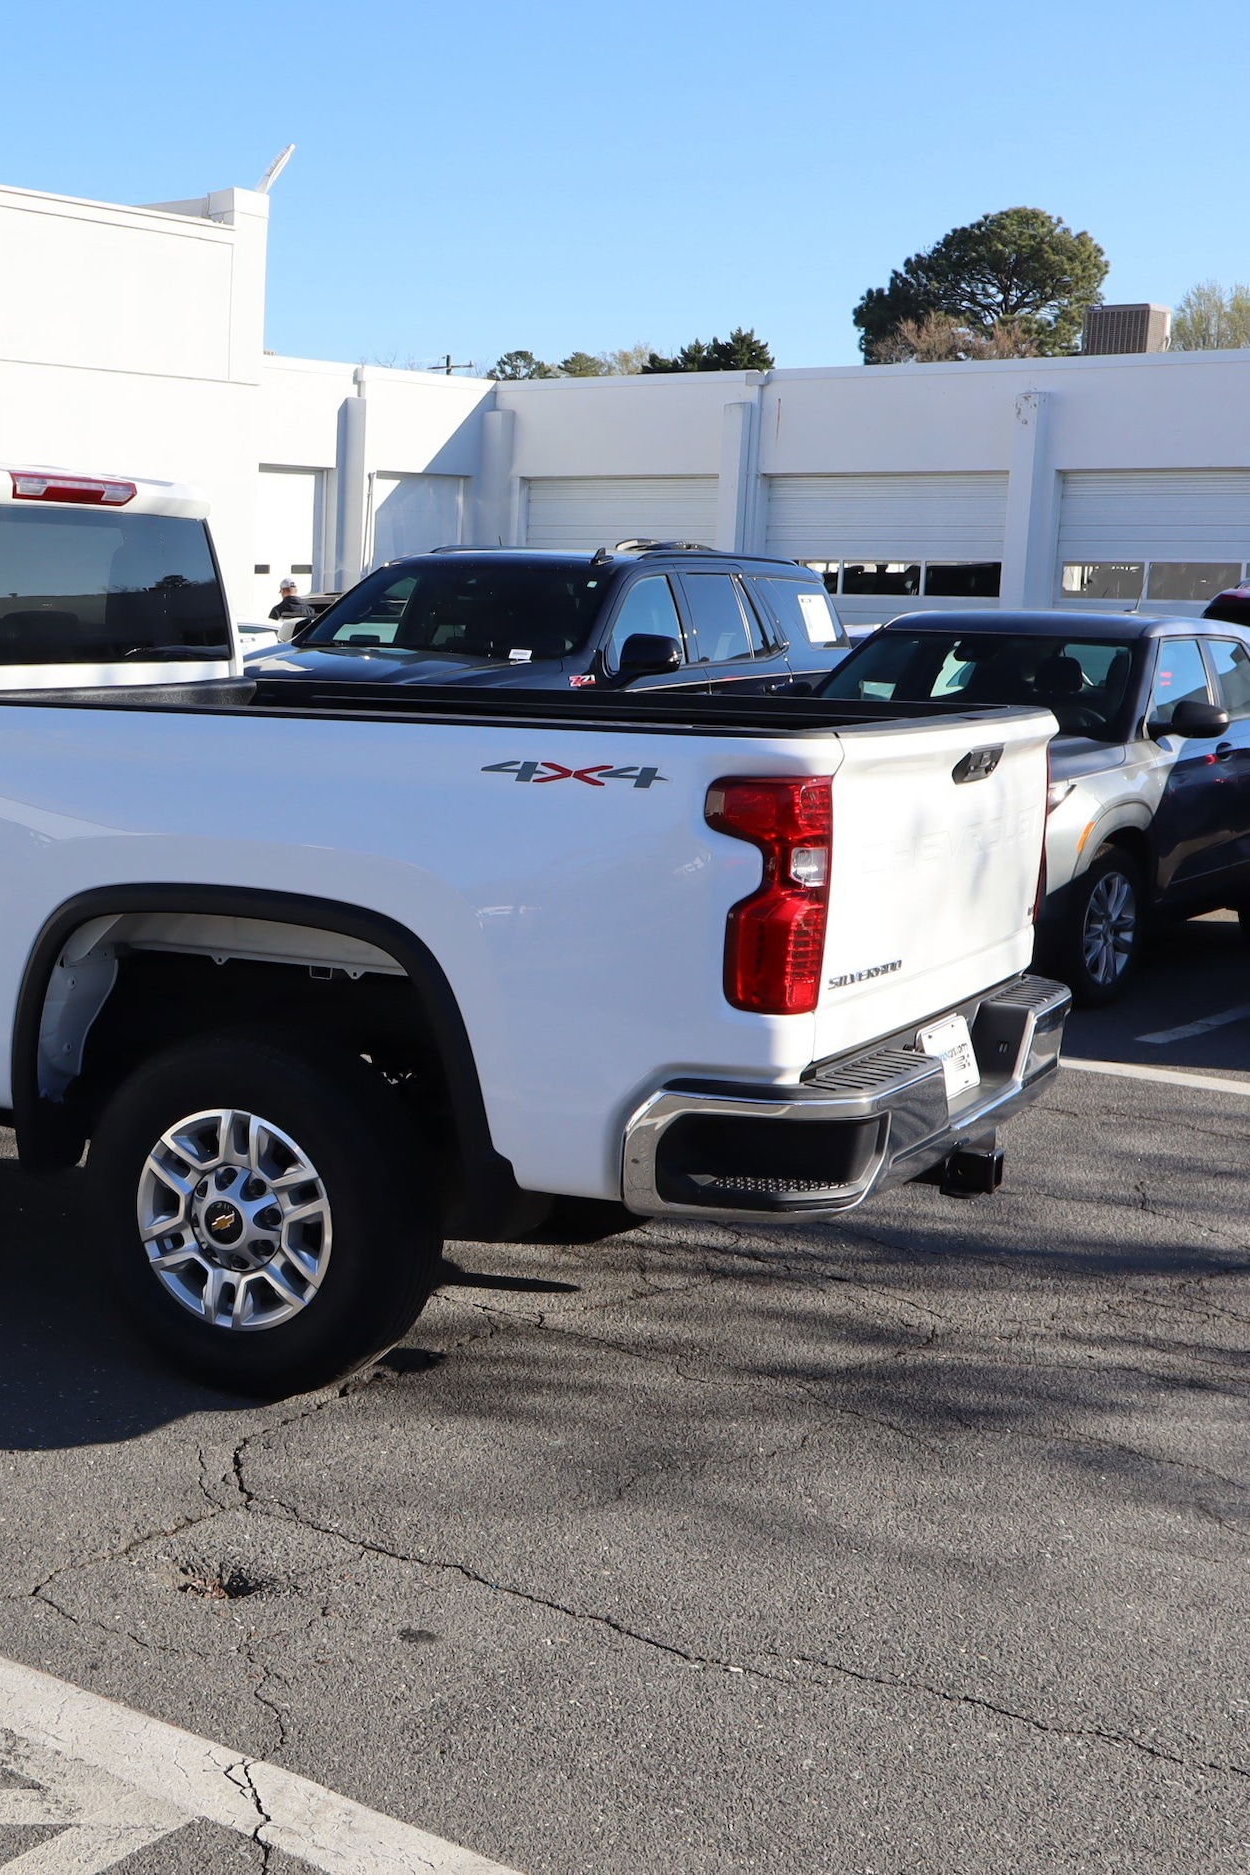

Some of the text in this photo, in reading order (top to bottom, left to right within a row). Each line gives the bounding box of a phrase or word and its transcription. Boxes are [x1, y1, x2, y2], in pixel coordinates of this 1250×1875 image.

[569, 674, 596, 687] Z71
[862, 805, 1037, 875] CHEVROLET
[827, 959, 902, 990] SILVERADO
